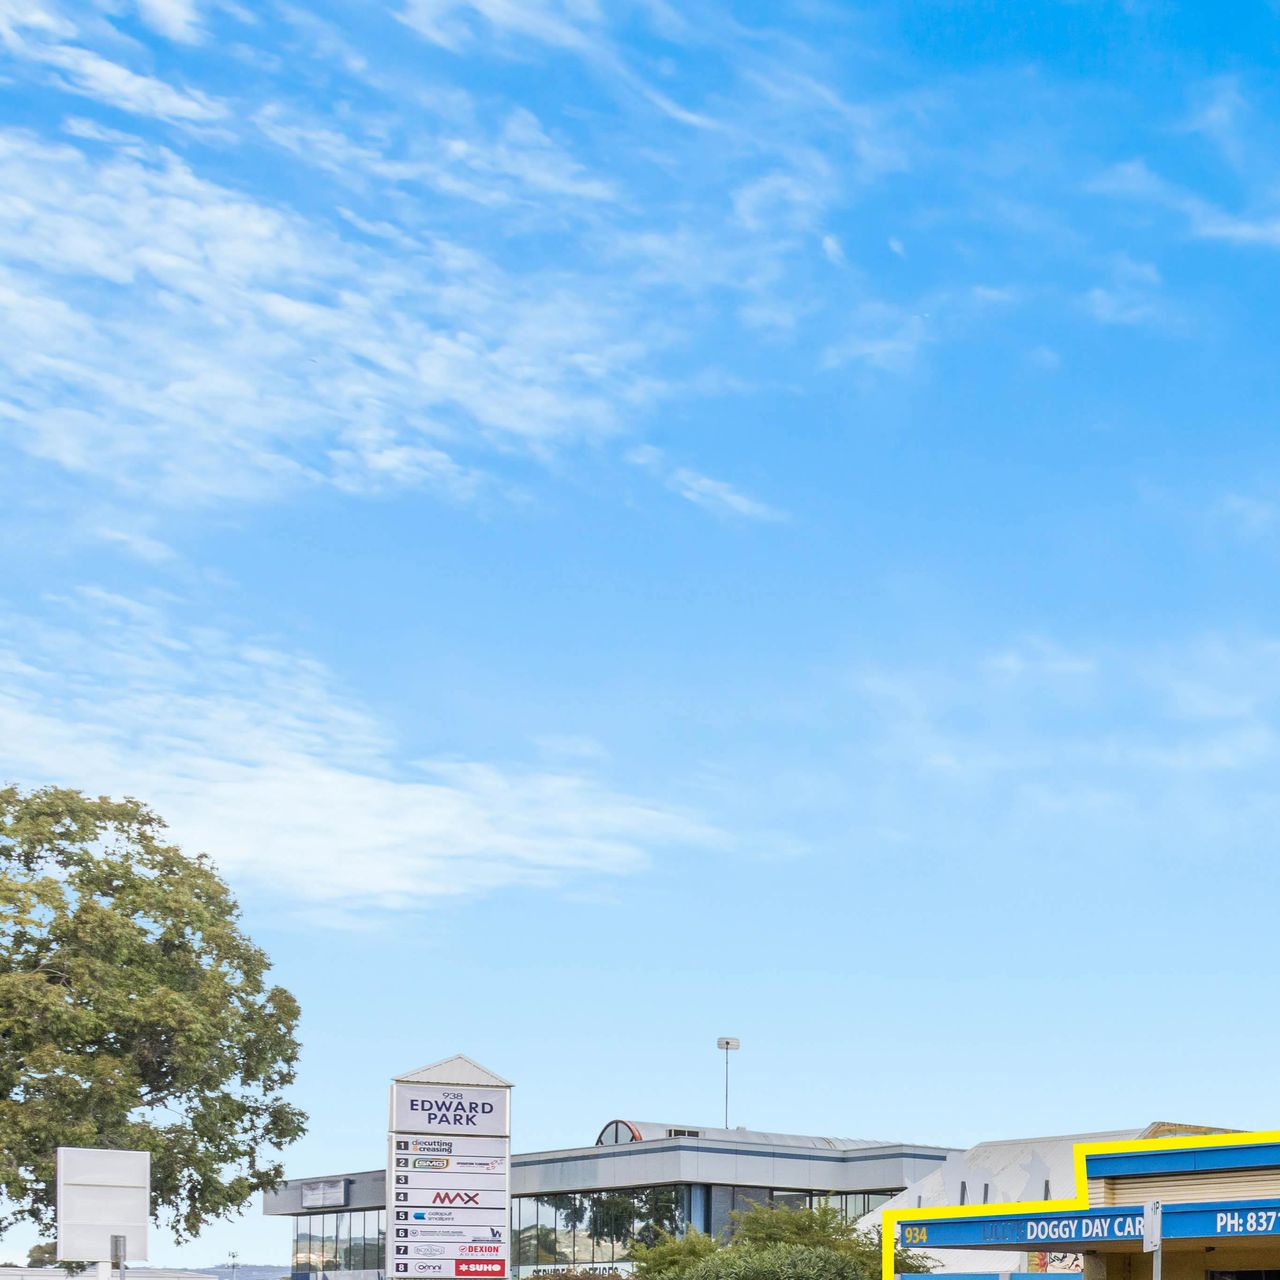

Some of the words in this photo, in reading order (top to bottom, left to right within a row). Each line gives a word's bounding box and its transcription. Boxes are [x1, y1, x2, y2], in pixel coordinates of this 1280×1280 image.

[442, 1092, 463, 1100] 938
[410, 1099, 494, 1114] EDWARD
[427, 1113, 477, 1126] PARK
[432, 1192, 479, 1205] MAX
[1216, 1212, 1243, 1233] PH:
[904, 1226, 928, 1244] 934
[1026, 1219, 1078, 1240] DOGGY
[1081, 1218, 1111, 1238] DAY
[1113, 1216, 1145, 1236] CAR
